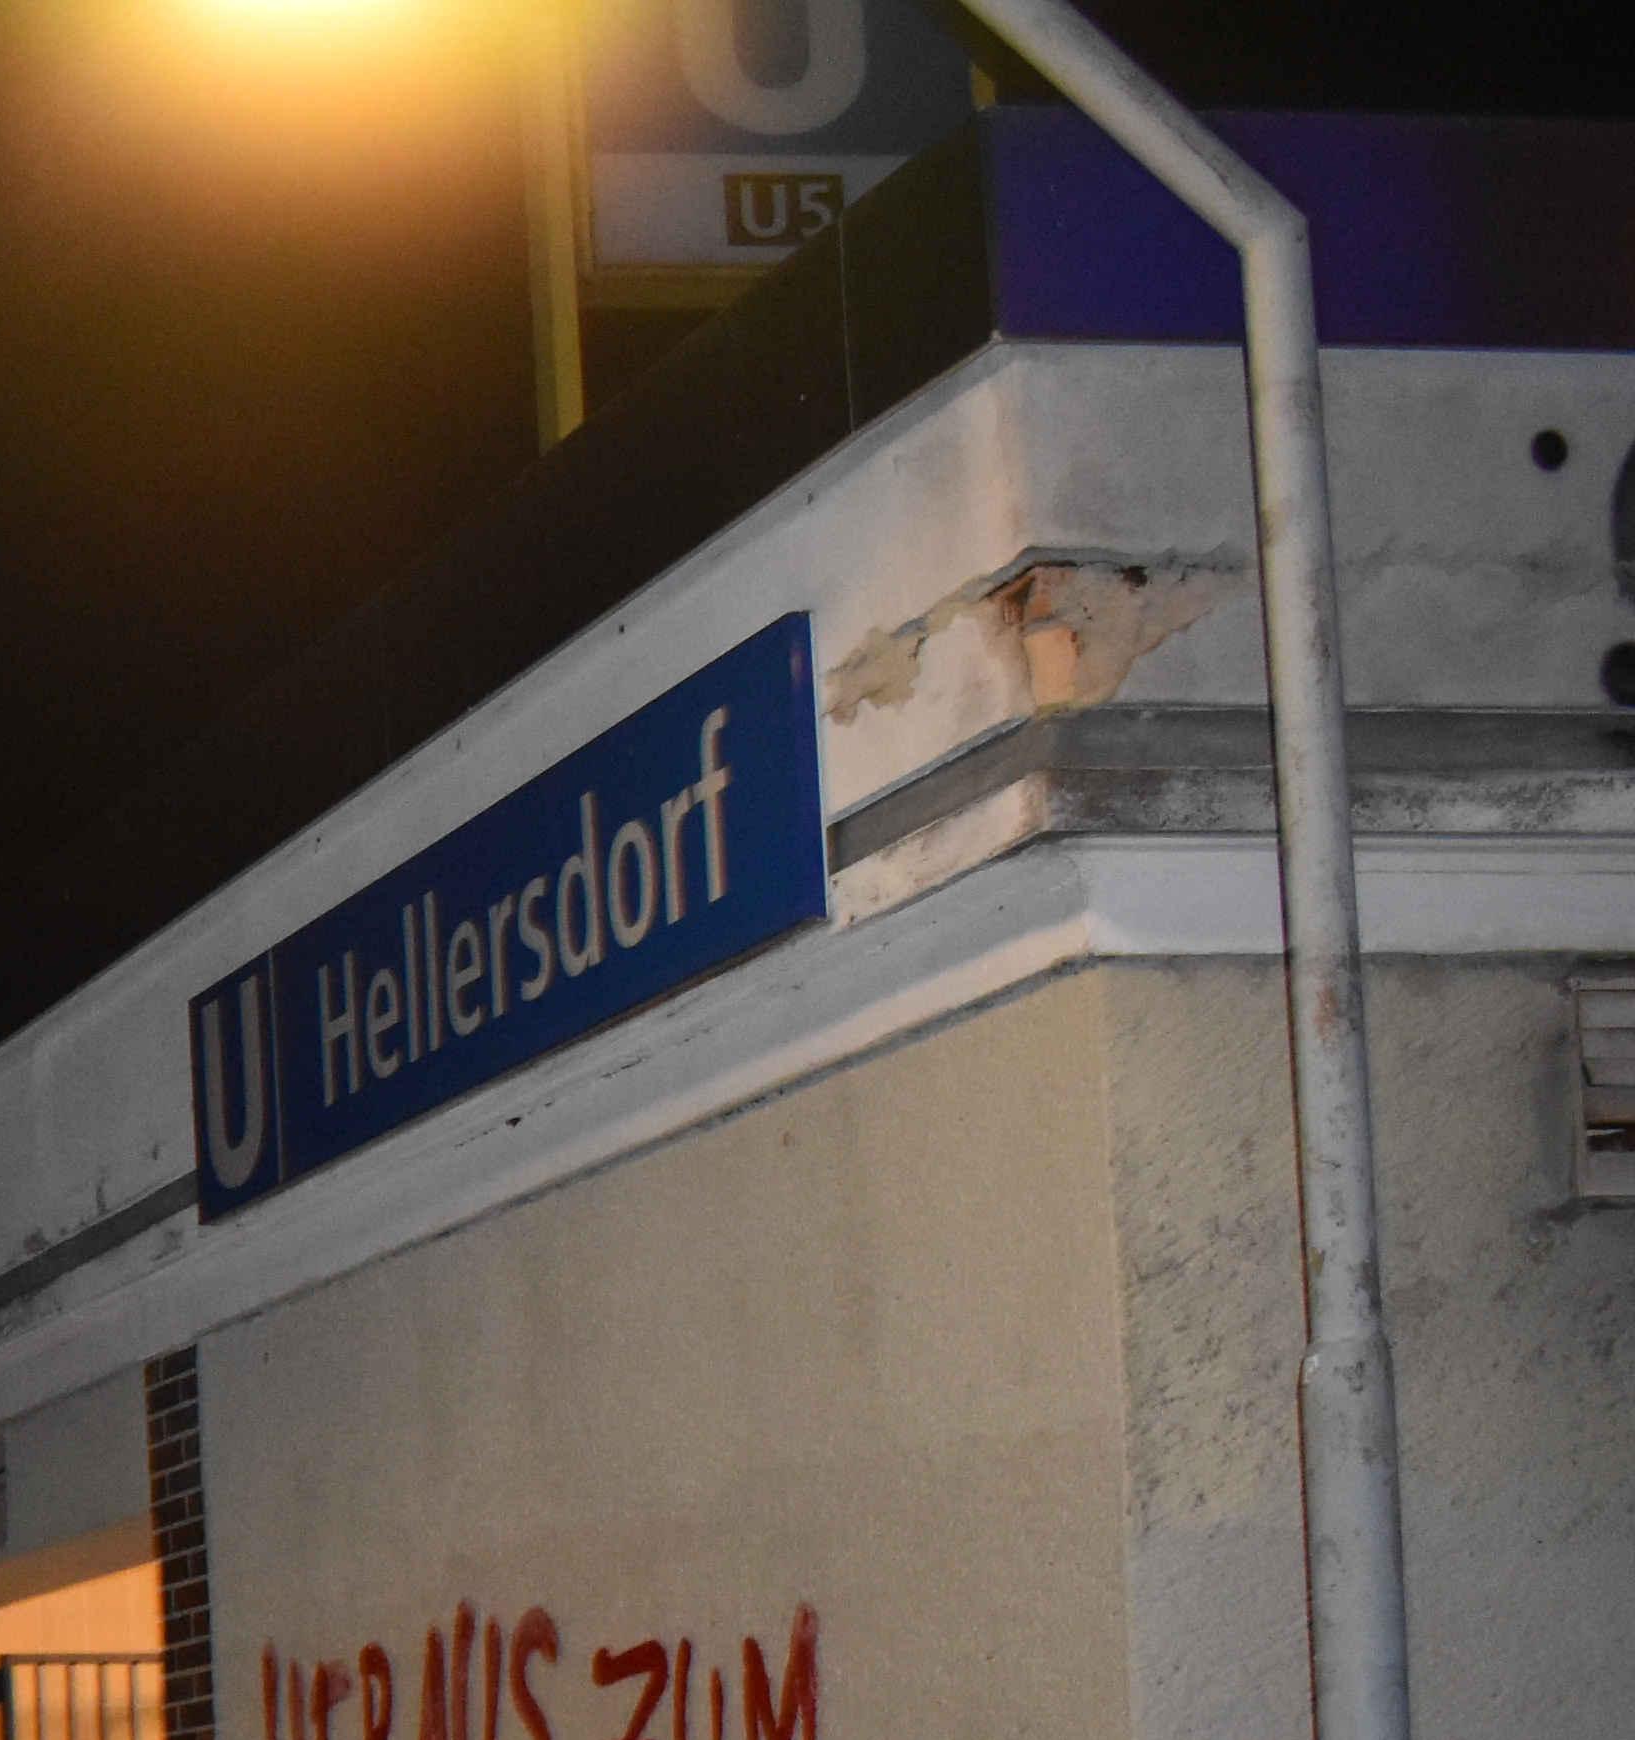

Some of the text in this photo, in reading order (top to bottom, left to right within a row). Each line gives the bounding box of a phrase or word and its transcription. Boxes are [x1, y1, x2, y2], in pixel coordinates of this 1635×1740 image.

[741, 181, 832, 238] U5
[200, 704, 732, 1189] U Hellersdorf
